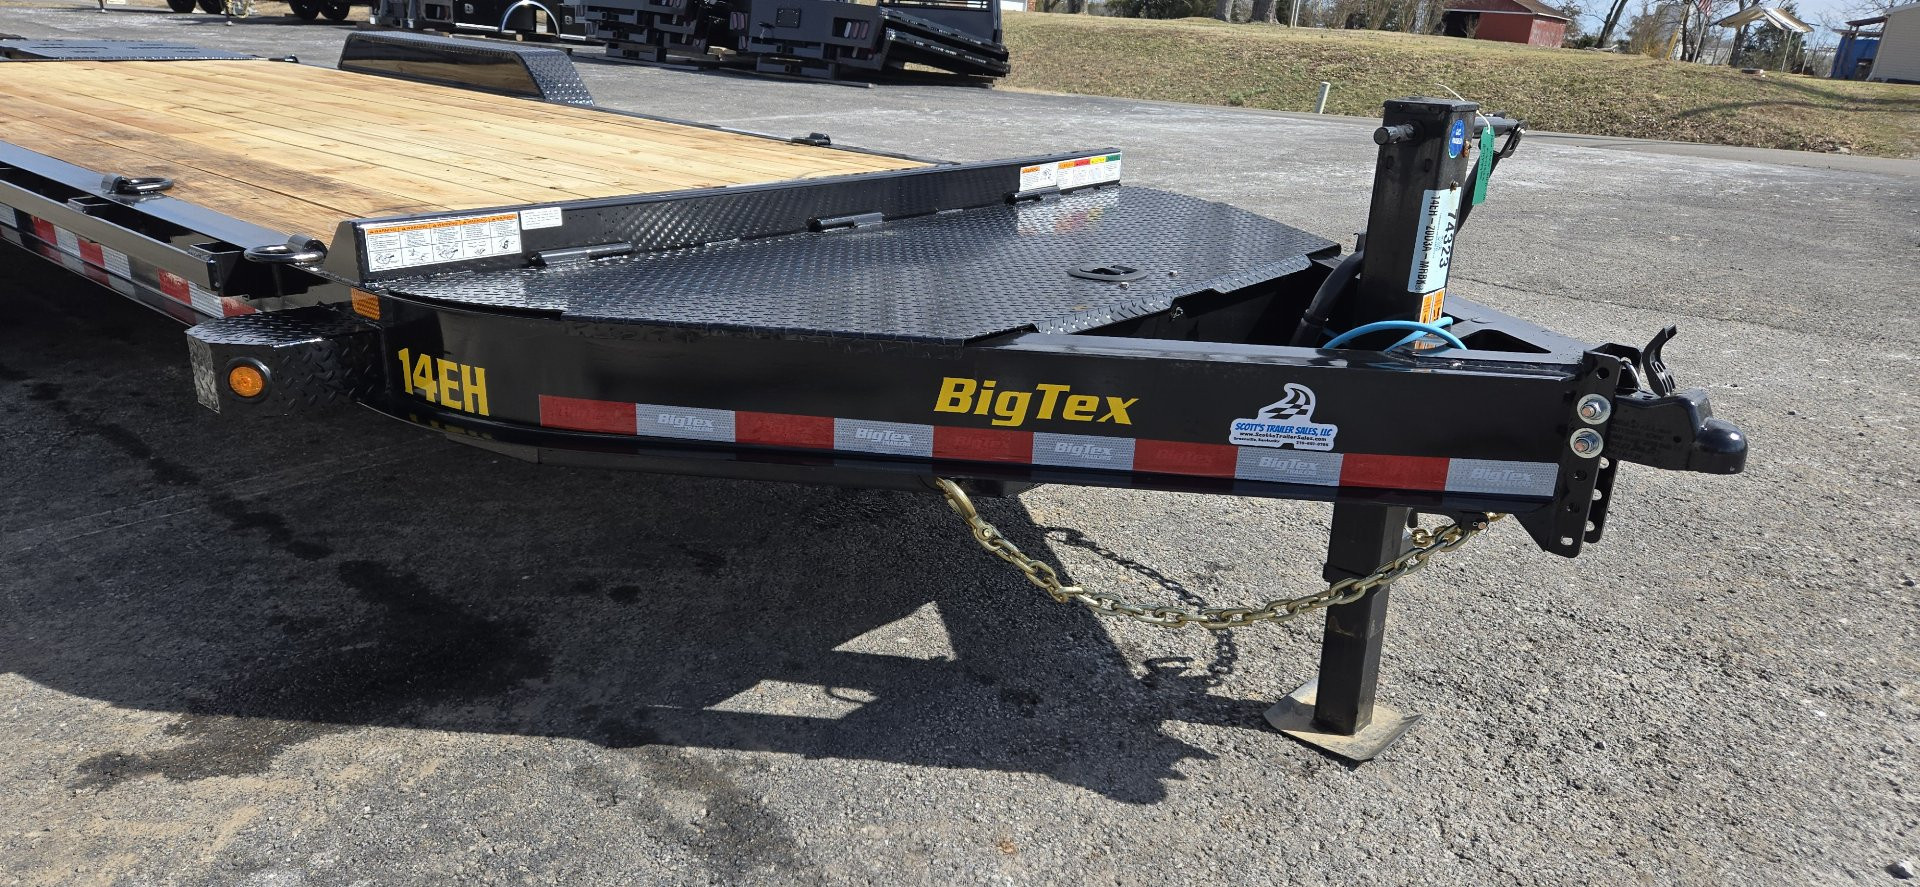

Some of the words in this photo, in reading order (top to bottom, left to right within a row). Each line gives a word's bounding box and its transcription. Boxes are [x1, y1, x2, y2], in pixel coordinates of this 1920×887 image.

[1439, 209, 1458, 268] 74323
[397, 348, 490, 416] 14EH
[934, 377, 1141, 427] BigTex
[658, 413, 714, 429] BigTex
[855, 427, 912, 442] BigTex
[1235, 423, 1265, 432] SCOTT'S
[1266, 425, 1293, 434] TRAILER
[1295, 427, 1318, 436] SALES,
[1320, 428, 1332, 437] LLC
[1055, 442, 1113, 456] BigTex
[1259, 456, 1319, 471] BigTex
